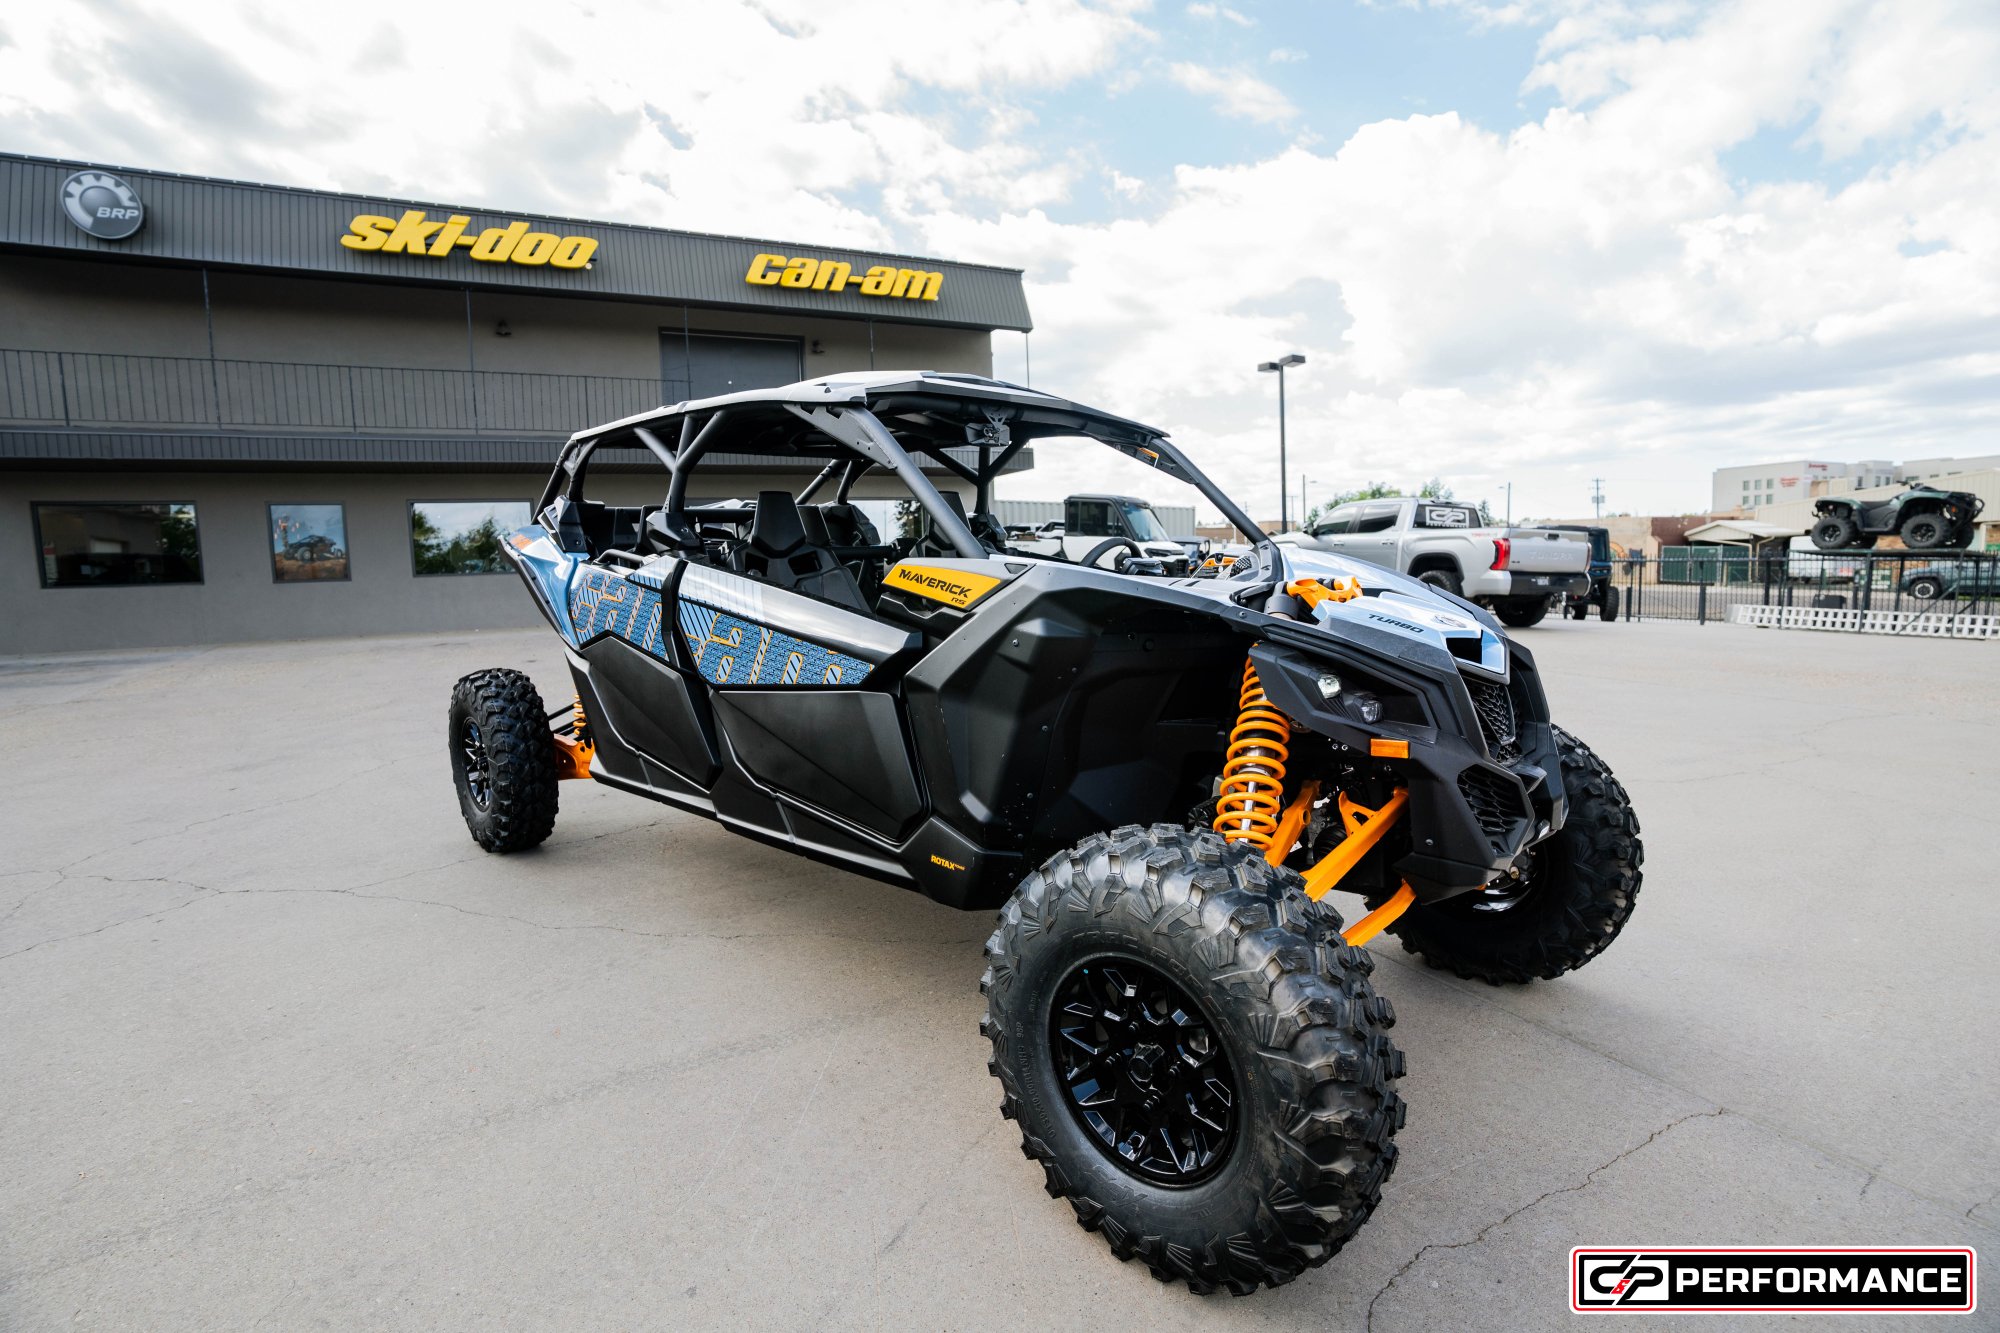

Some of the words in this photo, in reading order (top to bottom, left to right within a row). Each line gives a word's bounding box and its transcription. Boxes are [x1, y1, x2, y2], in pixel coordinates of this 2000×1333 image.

[96, 206, 140, 220] BRP
[339, 210, 599, 269] ski-doo
[745, 253, 944, 301] can-am
[1529, 551, 1573, 560] TUNDRA
[898, 568, 973, 599] MAVERICK
[950, 596, 967, 606] RS
[1368, 613, 1425, 634] TURBO
[930, 854, 955, 871] ROTAX
